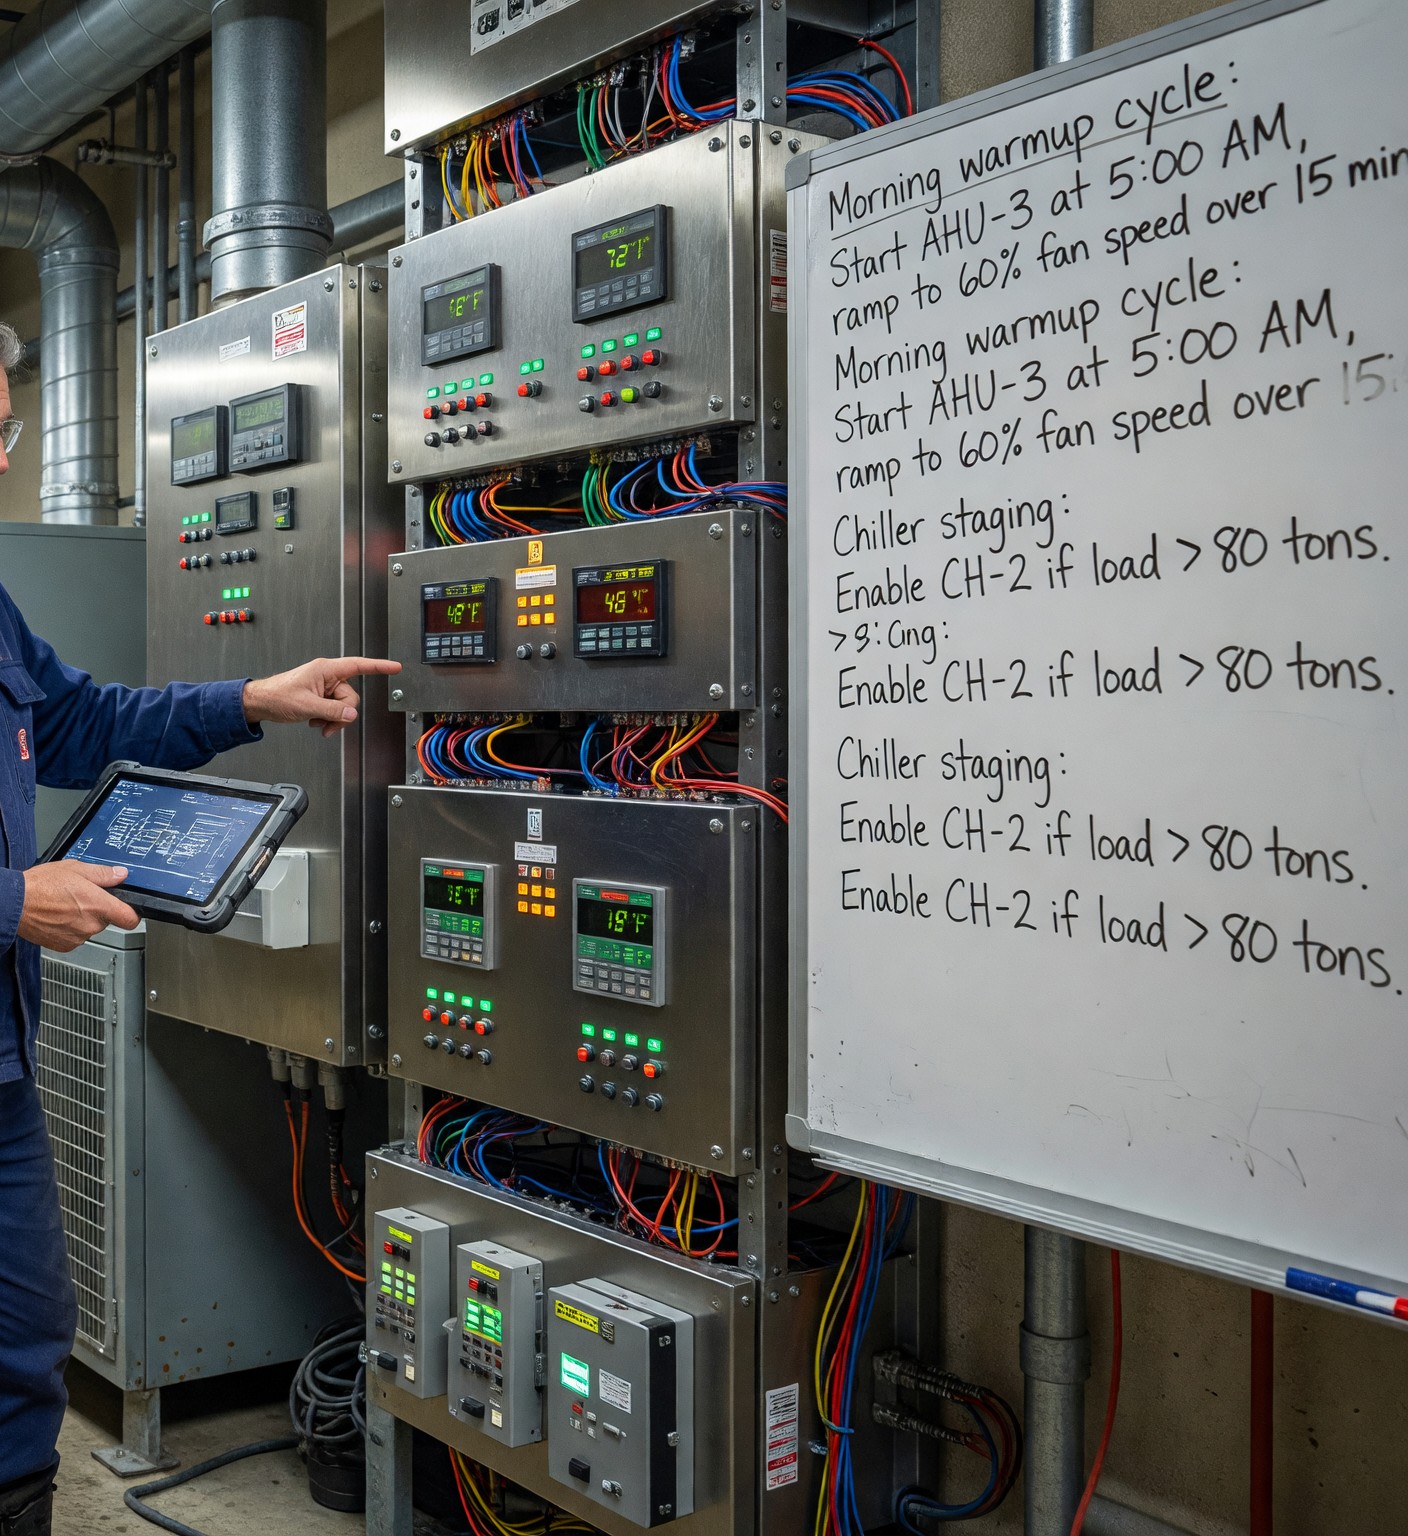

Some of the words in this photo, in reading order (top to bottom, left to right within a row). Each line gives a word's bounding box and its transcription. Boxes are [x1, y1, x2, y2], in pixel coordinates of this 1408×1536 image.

[829, 168, 942, 231] Morning
[960, 114, 1094, 181] warmup
[1115, 61, 1238, 144] cycle:
[830, 231, 907, 287] Start
[922, 189, 1033, 261] AHU-3
[1051, 170, 1091, 216] at
[1110, 140, 1203, 200] 5:00
[1222, 102, 1306, 168] AM,
[833, 295, 899, 336] ramp
[911, 273, 941, 309] to
[959, 242, 1021, 297] 60%
[1037, 231, 1089, 272] fan
[1104, 193, 1190, 266] speed
[1206, 182, 1277, 224] over
[1296, 154, 1336, 204] 15
[835, 391, 912, 443] Start
[929, 362, 1046, 425] AHU-3
[1067, 345, 1109, 390] at
[1132, 322, 1237, 377] 5:00
[1259, 288, 1354, 353] AM,
[836, 338, 947, 391] Morning
[966, 299, 1099, 355] warmup
[1121, 257, 1241, 332] cycle:
[837, 458, 900, 497] ramp
[912, 438, 942, 476] to
[959, 417, 1022, 468] 60%
[1036, 409, 1095, 453] fan
[1112, 379, 1211, 453] speed
[1234, 378, 1320, 419] over
[834, 509, 925, 556] Chiller
[941, 494, 1069, 554] staging:
[837, 564, 926, 613] Enable
[942, 554, 1032, 599] CH-2
[1047, 543, 1074, 589] if
[1093, 533, 1161, 586] load
[1176, 538, 1201, 571] >
[1213, 526, 1268, 573] 80
[1282, 516, 1389, 564] tons.
[828, 630, 847, 652] >
[839, 664, 928, 708] Enable
[943, 658, 1033, 702] CH-2
[1049, 650, 1074, 697] if
[1094, 646, 1162, 696] load
[1179, 654, 1204, 687] >
[1217, 646, 1272, 692] 80
[1286, 641, 1394, 695] tons.
[838, 736, 926, 780] Chiller
[941, 738, 1066, 808] staging:
[841, 801, 929, 846] Enable
[943, 806, 1030, 853] CH-2
[1046, 810, 1071, 856] if
[1089, 814, 1154, 867] load
[1167, 829, 1189, 862] >
[1202, 825, 1252, 871] 80
[1264, 826, 1367, 890] tons.
[842, 869, 931, 918] Enable
[946, 878, 1037, 930] CH-2
[1052, 889, 1079, 938] if
[1099, 895, 1167, 952] load
[1184, 914, 1208, 949] >
[1222, 913, 1277, 963] 80
[1292, 919, 1402, 995] tons.
